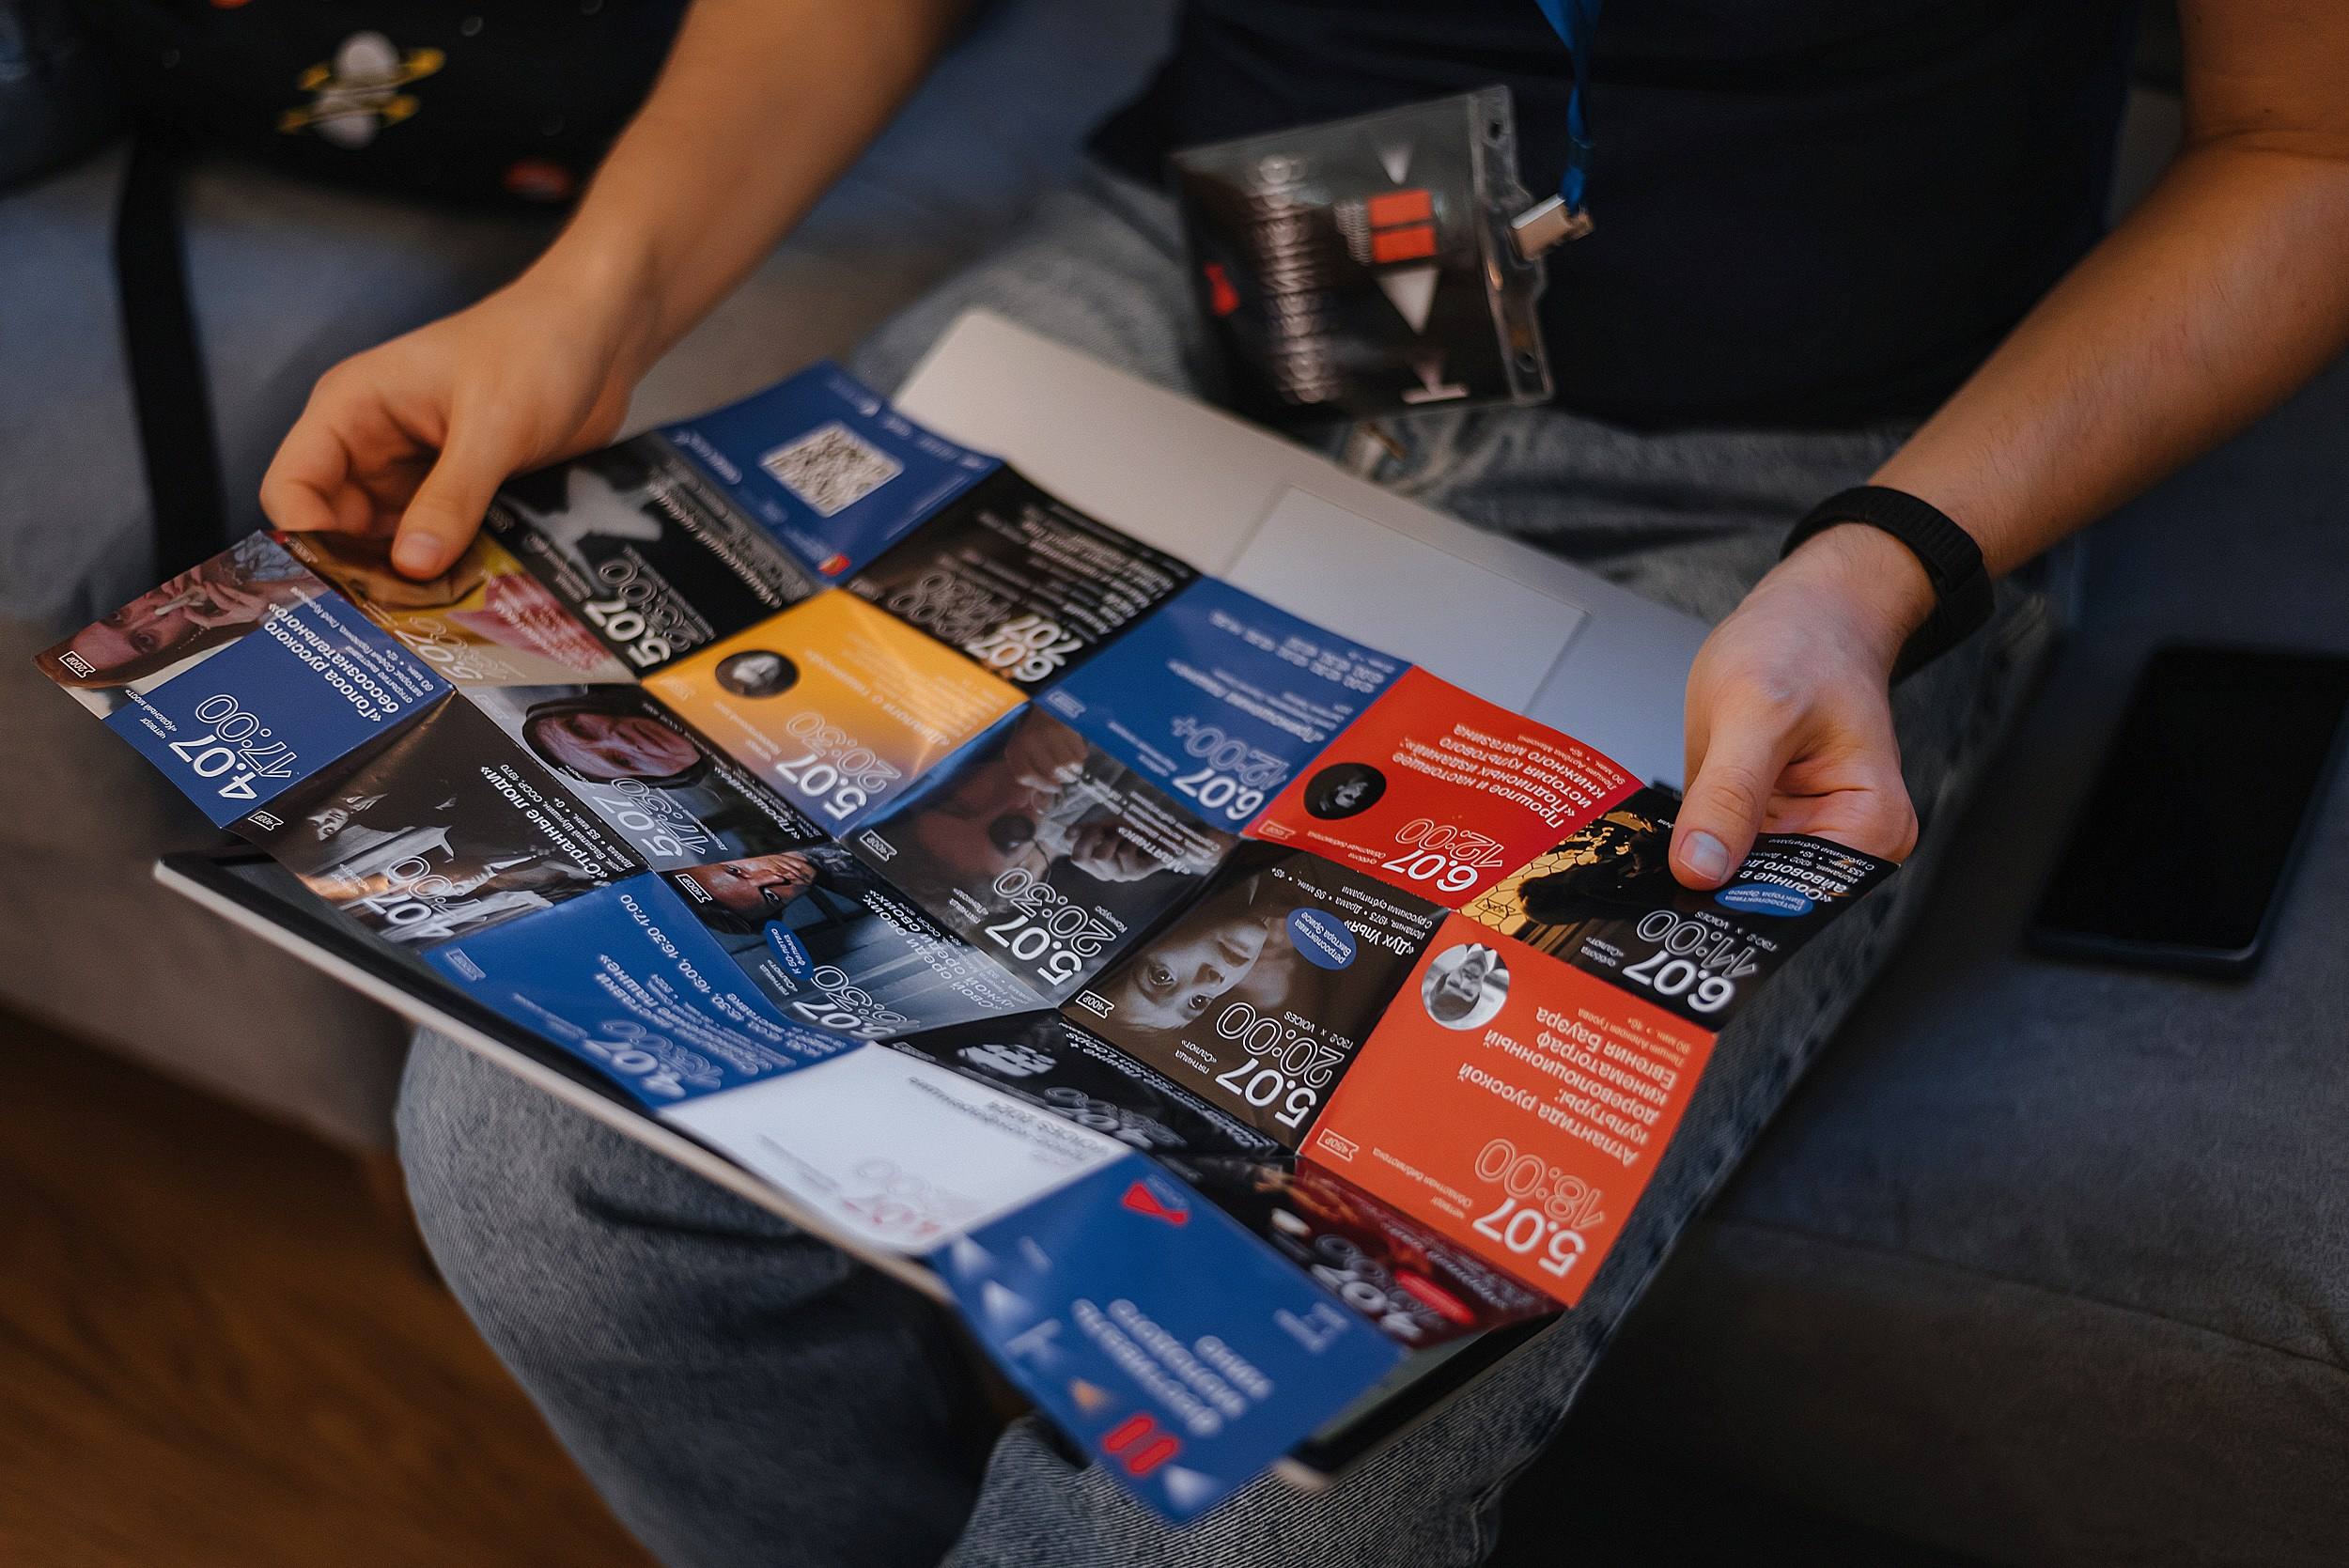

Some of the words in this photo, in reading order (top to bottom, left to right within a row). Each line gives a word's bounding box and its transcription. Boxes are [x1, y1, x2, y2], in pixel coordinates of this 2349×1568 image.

[263, 619, 329, 672] русского
[582, 591, 677, 668] 5.07
[998, 610, 1088, 663] 7.07
[265, 600, 401, 713] бессознательного»
[396, 629, 484, 680] 5.07
[966, 629, 1057, 683] 6.07
[124, 687, 147, 706] мост»
[319, 669, 386, 723] «Голоса
[420, 679, 435, 691] 60
[140, 716, 167, 738] четверг
[143, 703, 179, 733] «Красный
[193, 691, 305, 783] 17:00
[783, 708, 901, 794] 20:30
[1396, 737, 1479, 771] изданий»:
[1438, 735, 1525, 769] культового
[1451, 723, 1527, 755] магазина
[170, 728, 268, 805] 4.07
[474, 765, 532, 809] люди»
[499, 764, 521, 781] 1970
[774, 748, 869, 819] 5.07
[1390, 751, 1477, 785] настоящее
[1521, 764, 1595, 806] история
[1526, 751, 1609, 798] книжного
[1581, 767, 1620, 789] Лекция
[1610, 774, 1626, 784] 90
[710, 766, 805, 839] «Прощание»
[1174, 758, 1264, 824] 6.07
[1477, 764, 1582, 816] «Подписных
[1486, 783, 1566, 827] Прошлое
[594, 793, 688, 859] 5.07
[608, 776, 719, 855] 17:30
[521, 808, 610, 879] «Странные
[569, 829, 608, 859] Василий
[604, 845, 635, 868] Драма
[1116, 825, 1190, 877] «Маятник»
[1392, 816, 1519, 871] 12:00
[1816, 847, 1867, 866] русскими
[1293, 878, 1317, 892] мин.
[1381, 845, 1485, 893] 6.07
[1738, 869, 1753, 878] в
[1751, 869, 1837, 904] «Солнце
[1761, 860, 1848, 894] айвового
[1810, 863, 1859, 883] Испания.
[616, 893, 653, 926] 17:00
[856, 893, 909, 935] своих,
[865, 889, 924, 931] своих»
[947, 897, 981, 924] пятница
[990, 864, 1116, 958] 20:30
[1332, 896, 1363, 912] Драма
[1338, 885, 1390, 908] субтитрами
[1385, 903, 1427, 924] русскими
[1092, 905, 1128, 932] Конкурс
[1299, 911, 1325, 933] Эрисе
[1339, 918, 1384, 943] Улья»
[1368, 911, 1390, 924] 1973
[1692, 910, 1732, 928] VOICES
[644, 925, 680, 958] 16:30
[771, 928, 797, 970] 50-летию
[785, 934, 806, 966] фильма
[903, 939, 955, 979] среди
[916, 933, 966, 974] среди
[986, 908, 1085, 986] 5.07
[1293, 919, 1346, 963] ретроспектива
[1321, 929, 1352, 955] Виктора
[1379, 933, 1417, 957] «Дух
[1577, 945, 1618, 966] суббота
[1626, 909, 1769, 981] 11:00
[596, 954, 660, 1007] пашне»
[673, 958, 714, 992] 16:00,
[760, 964, 789, 996] пятница
[768, 959, 798, 992] «Салют»
[1620, 948, 1742, 1015] 6.07
[793, 1001, 895, 1038] 5.07
[1081, 994, 1106, 1011] 400₽
[1283, 1010, 1316, 1032] VOICES
[1066, 1032, 1117, 1058] Loops
[1211, 1000, 1344, 1089] 20:00
[1531, 1004, 1603, 1050] Бауэра
[1174, 1048, 1211, 1074] пятница
[1178, 1038, 1219, 1064] «Салют»
[1534, 1030, 1670, 1106] кинематограф
[1600, 1040, 1677, 1088] Евгения
[1217, 1051, 1317, 1127] 5.07
[1456, 1061, 1536, 1112] русской
[1481, 1028, 1658, 1126] дореволюционный
[1532, 1101, 1640, 1167] Атлантида
[1553, 1086, 1650, 1144] культуры:
[1471, 1134, 1613, 1236] 18:00
[1472, 1189, 1587, 1278] 5.07
